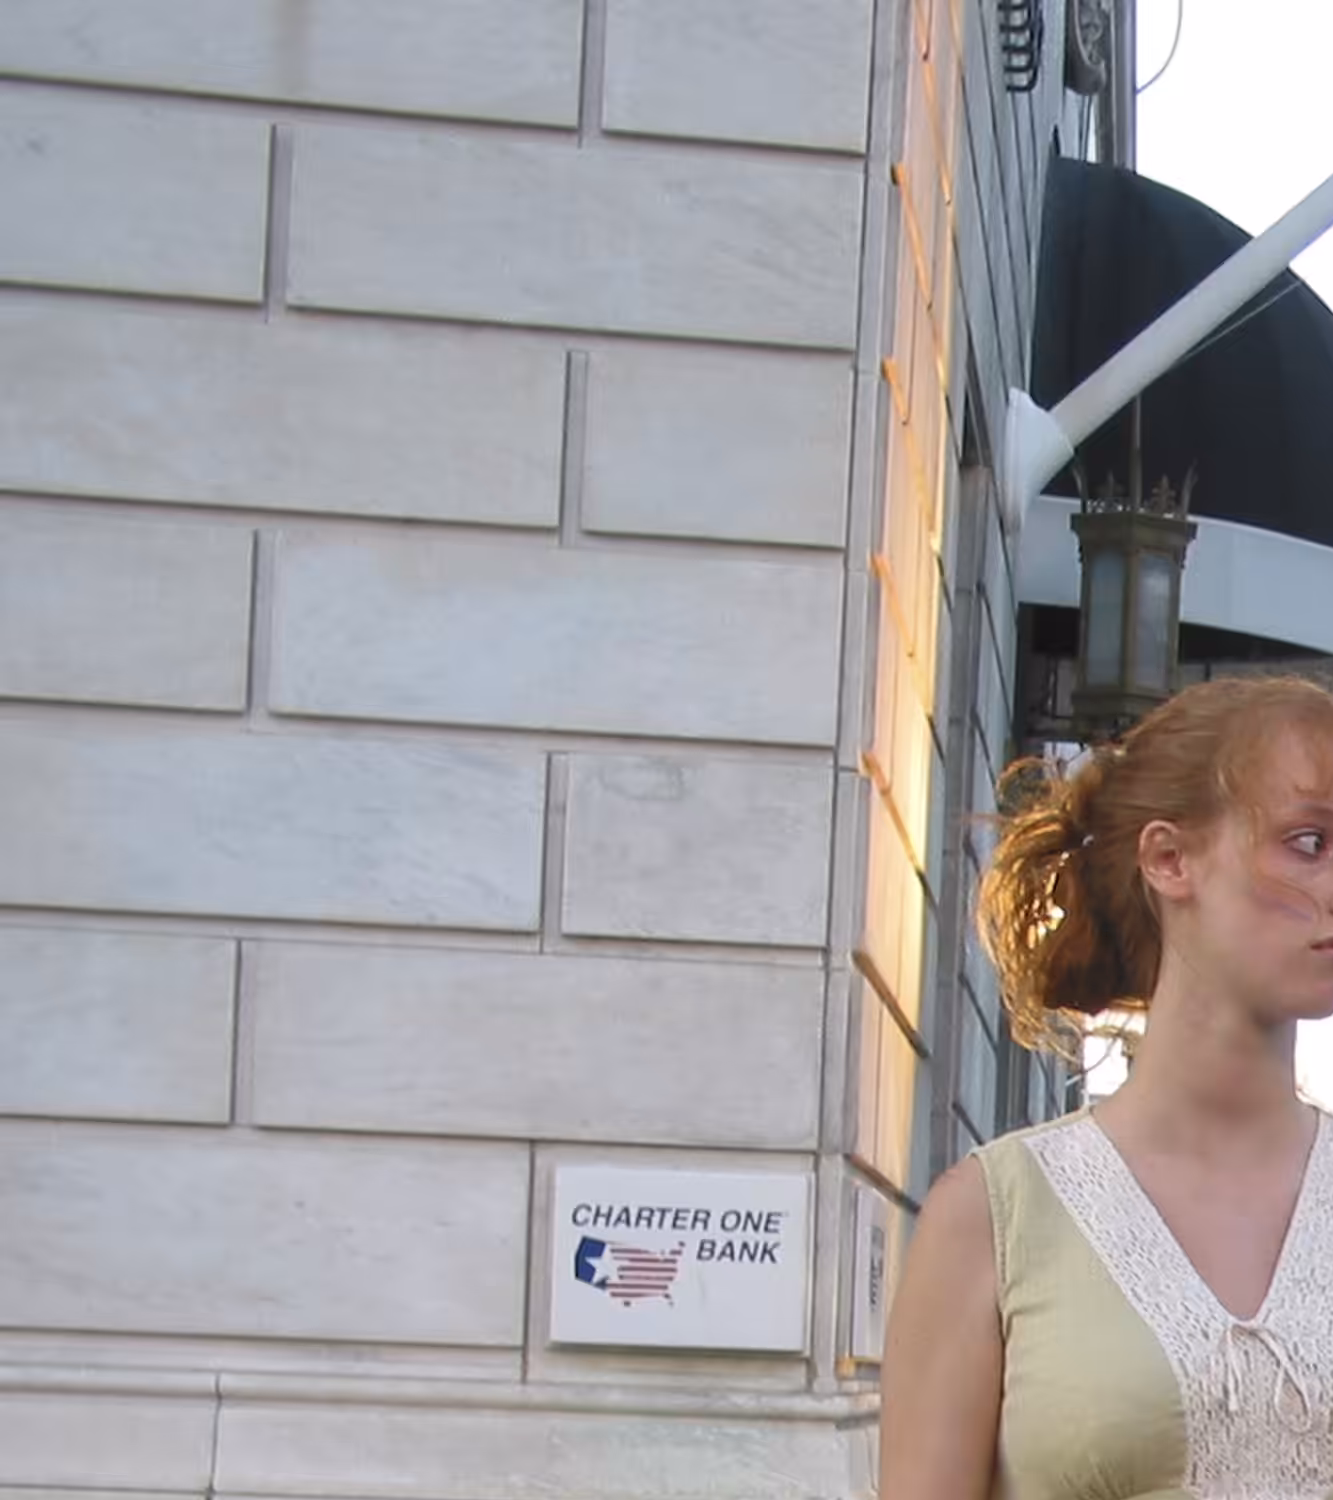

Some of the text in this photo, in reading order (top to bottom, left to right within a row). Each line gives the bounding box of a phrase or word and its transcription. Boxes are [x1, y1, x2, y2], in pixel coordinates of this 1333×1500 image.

[571, 1203, 782, 1234] CHARTER ONE
[695, 1238, 781, 1264] BANK
